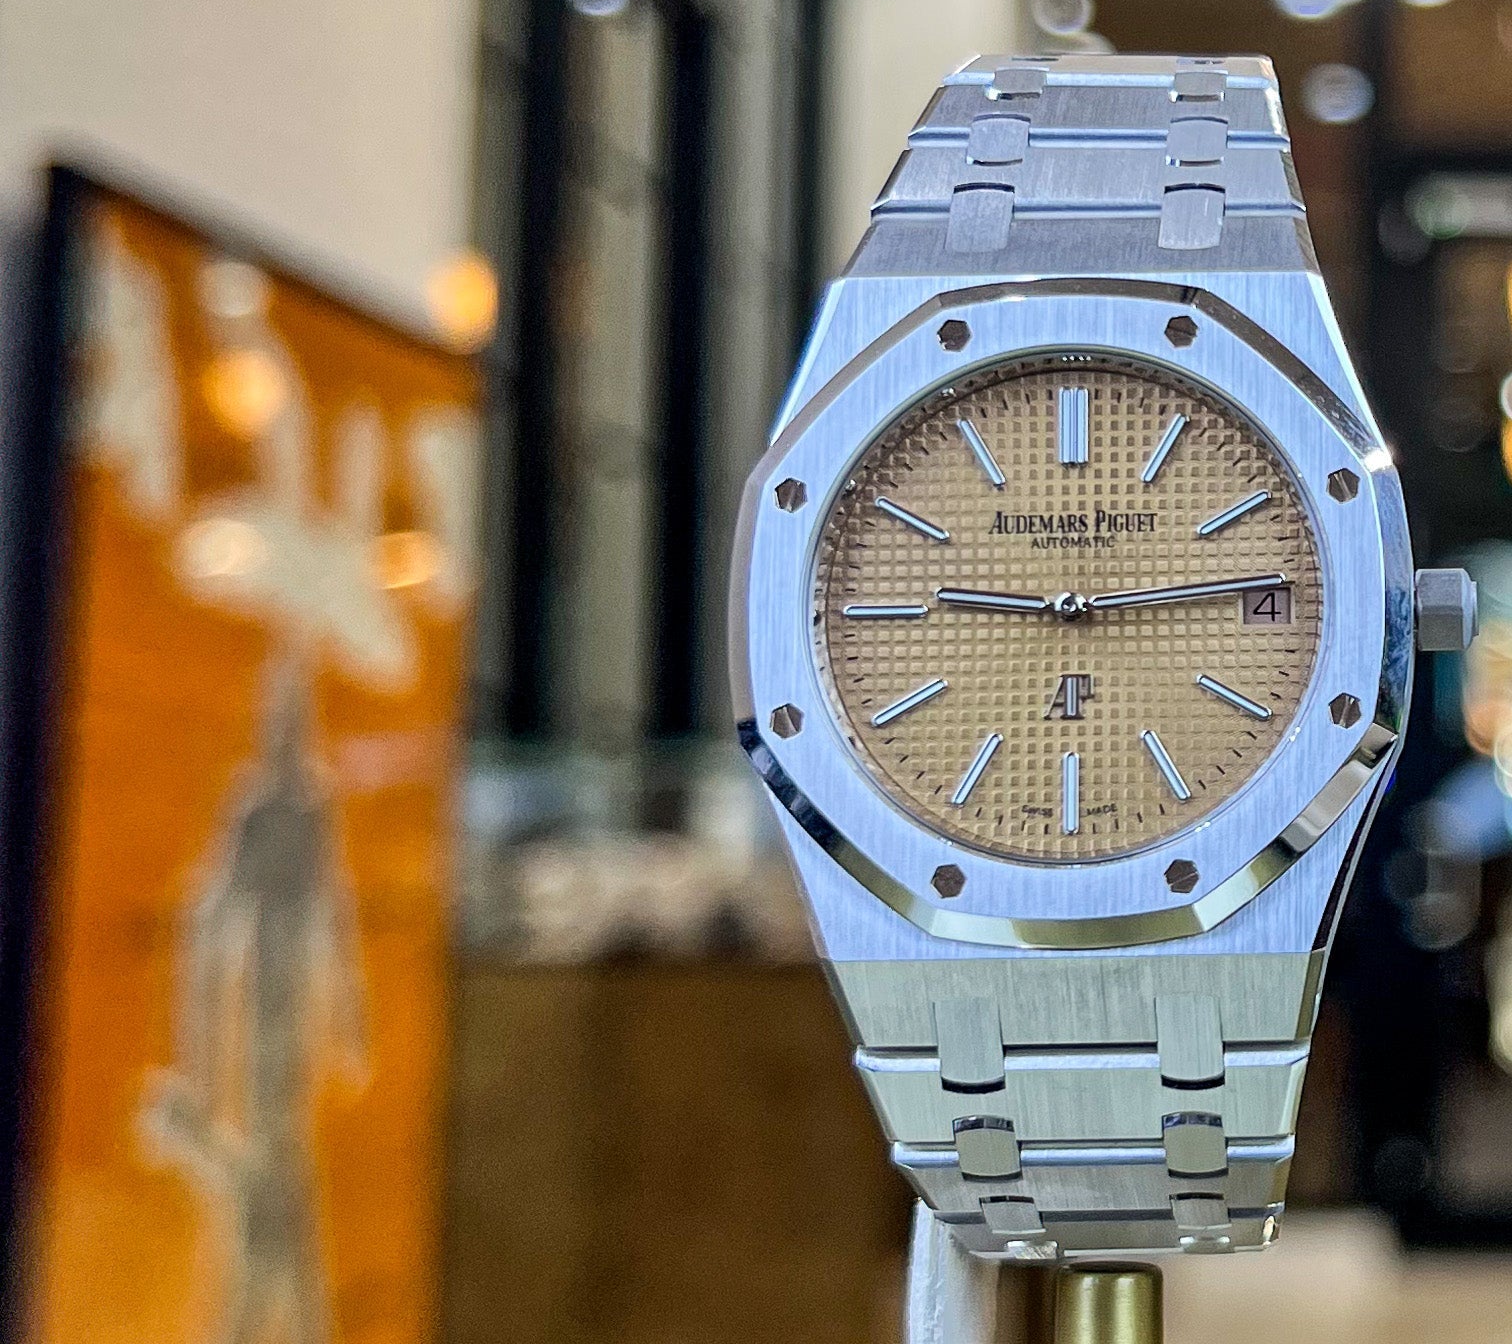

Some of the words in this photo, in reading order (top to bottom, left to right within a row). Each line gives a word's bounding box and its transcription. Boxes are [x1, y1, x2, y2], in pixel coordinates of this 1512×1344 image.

[988, 510, 1089, 535] AUDEMARS
[1095, 509, 1158, 533] PIGUET
[1030, 536, 1116, 550] AUTOMATIC
[1253, 592, 1282, 622] 4
